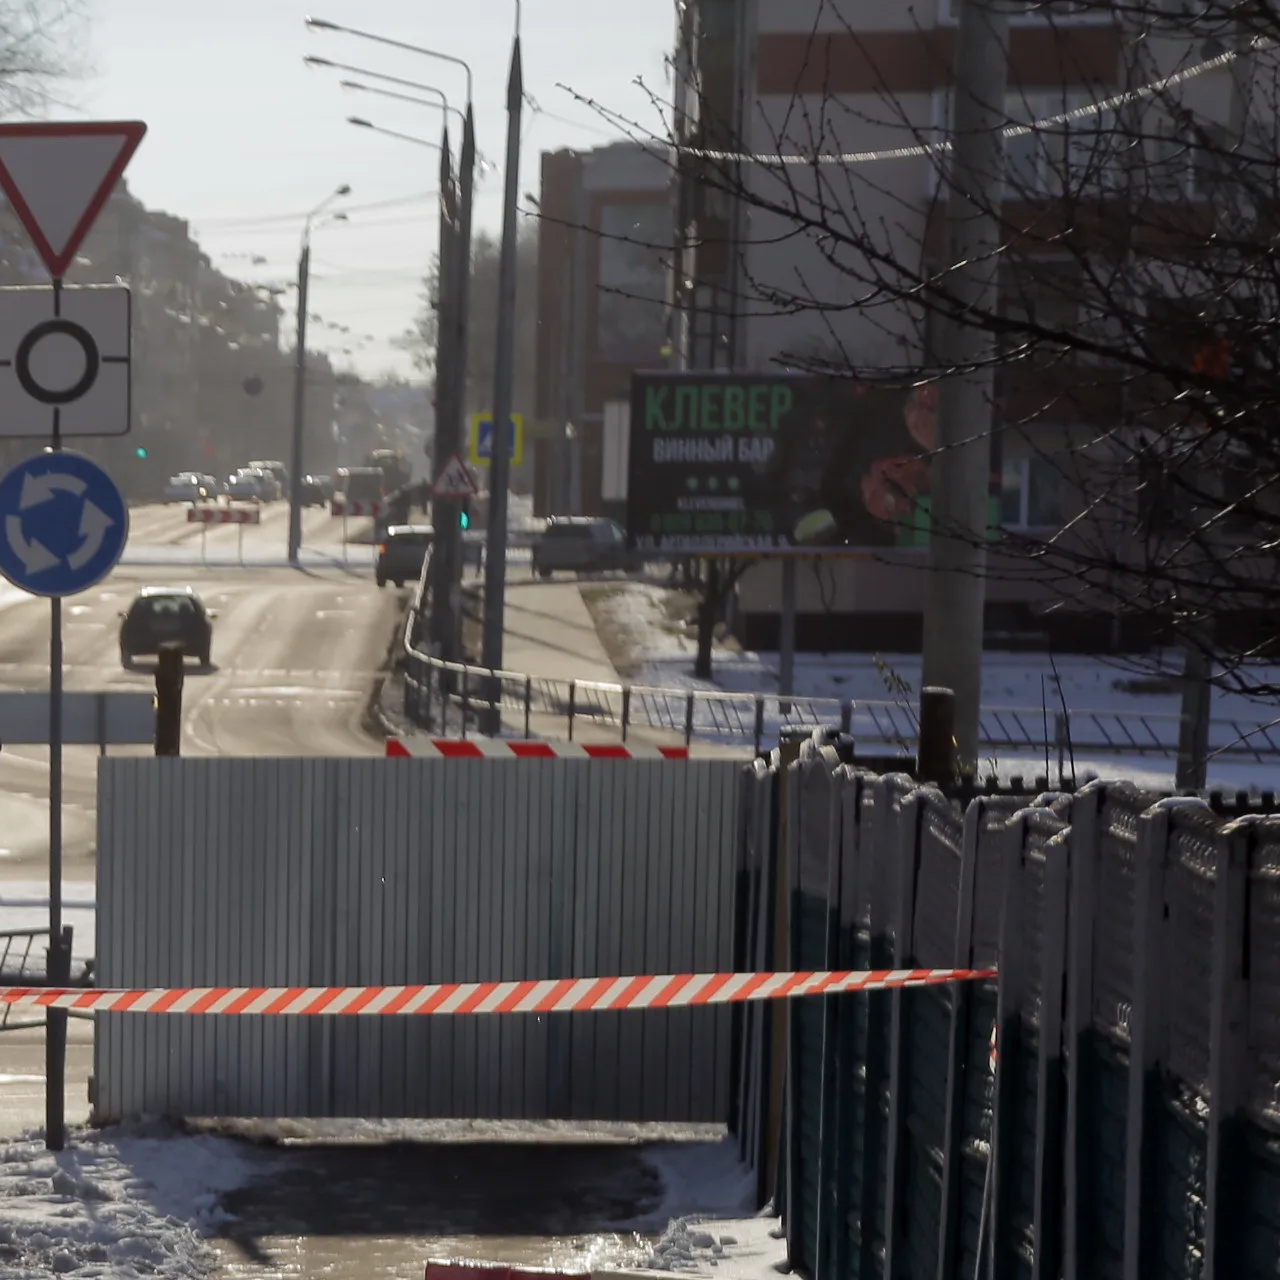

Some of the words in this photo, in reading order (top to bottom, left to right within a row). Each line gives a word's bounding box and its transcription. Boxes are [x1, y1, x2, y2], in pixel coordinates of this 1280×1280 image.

[644, 384, 793, 431] КЛЕВЕР
[652, 434, 734, 463] ВИННЫЙ
[738, 436, 776, 463] БАР
